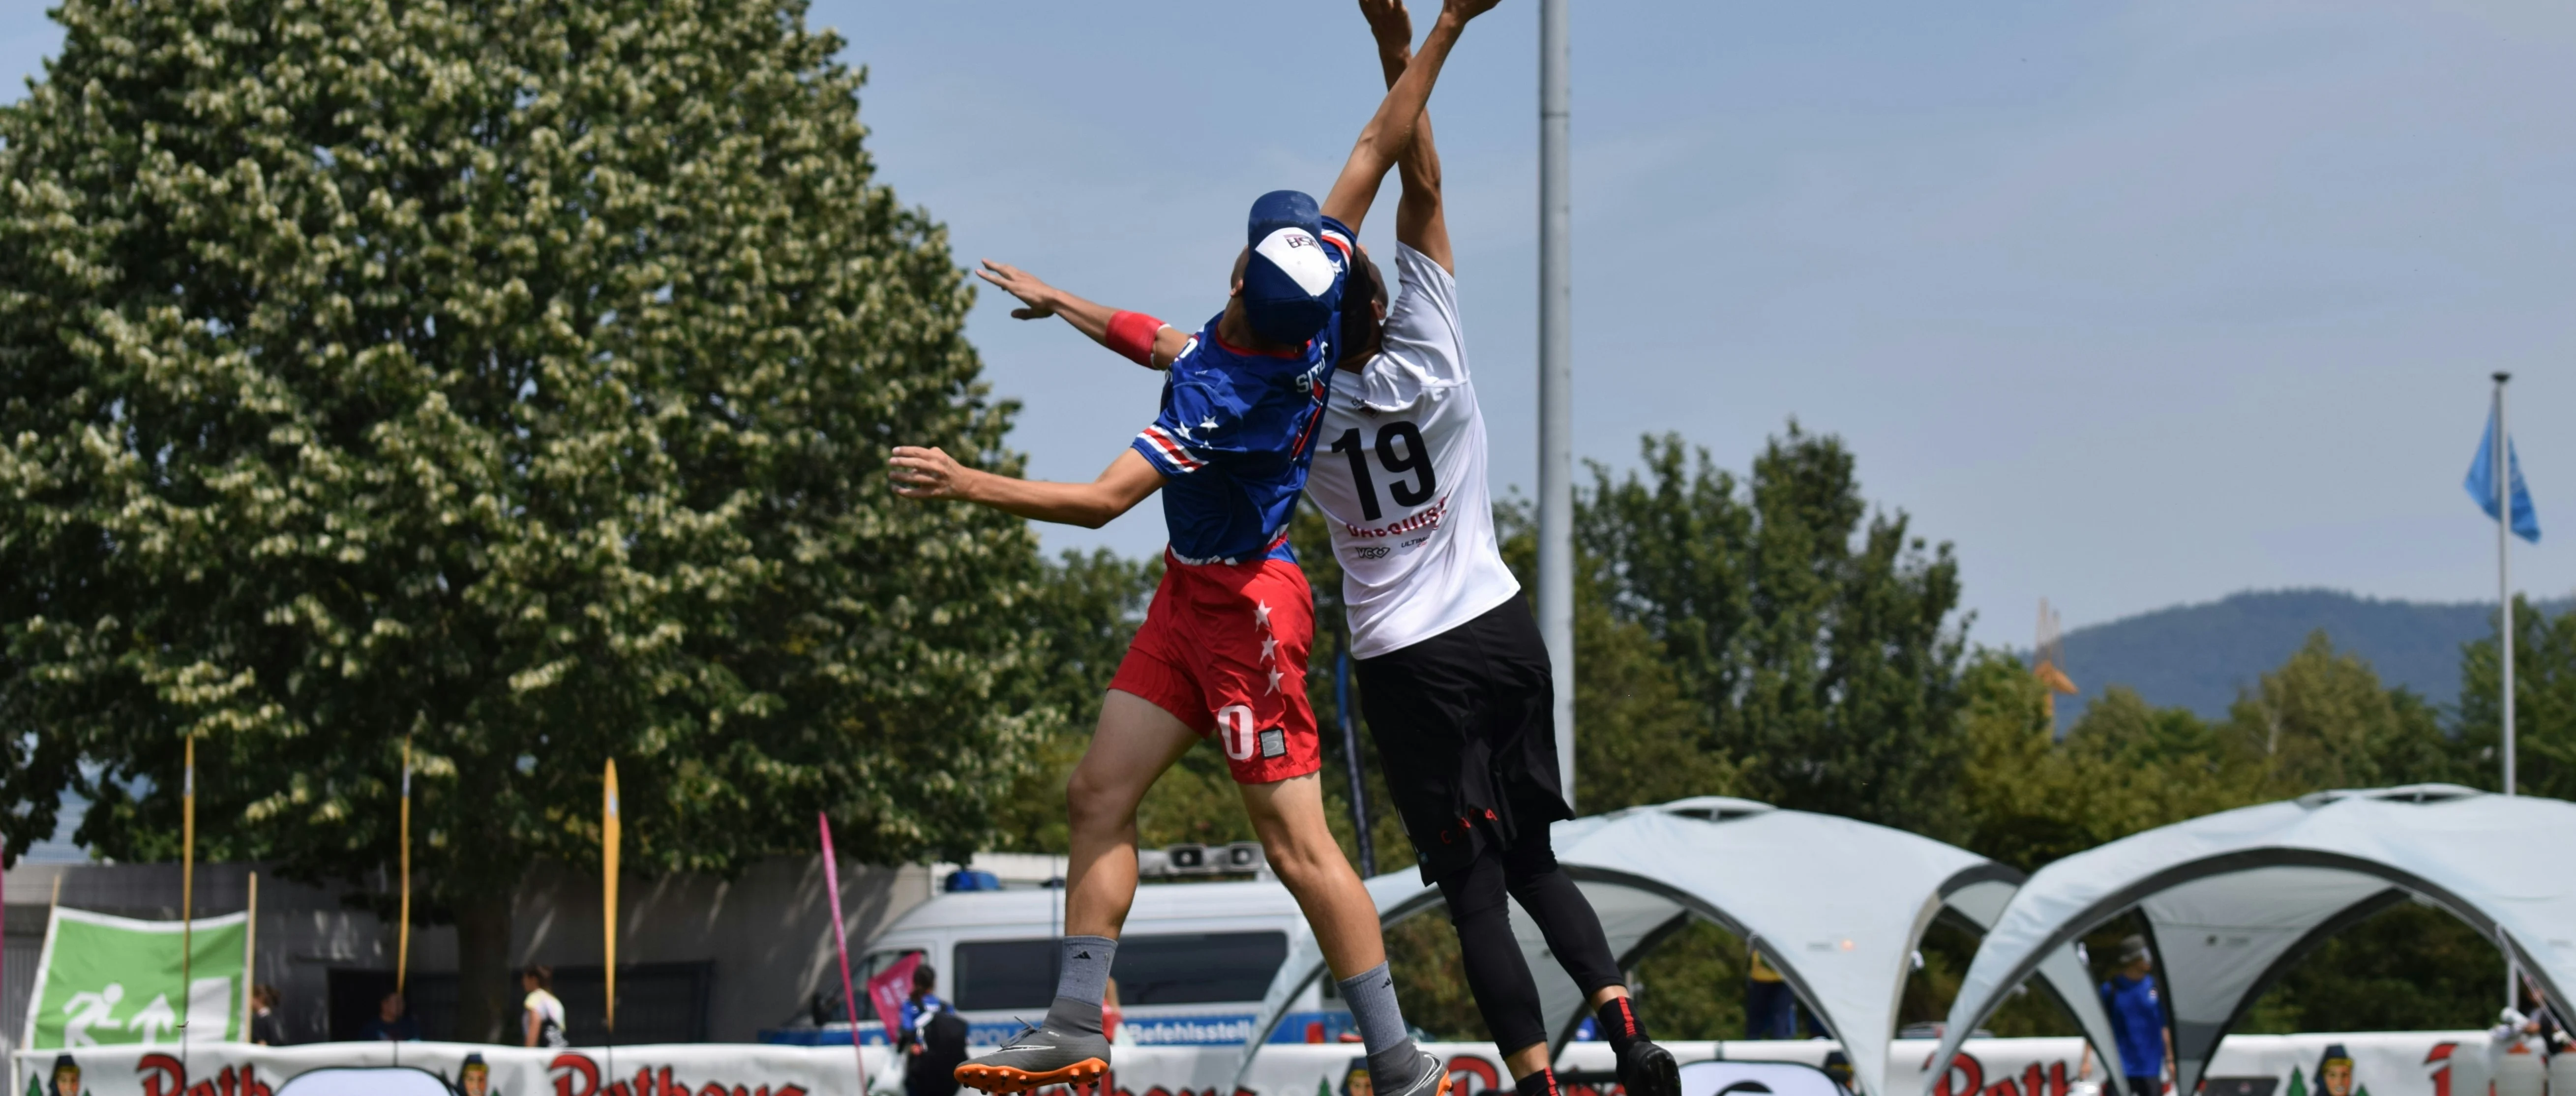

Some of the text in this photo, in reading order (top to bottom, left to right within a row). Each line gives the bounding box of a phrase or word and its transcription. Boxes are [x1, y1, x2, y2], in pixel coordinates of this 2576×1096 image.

[1331, 421, 1436, 521] 19
[1218, 705, 1254, 760] 0
[1128, 1019, 1252, 1043] Befehlsstell
